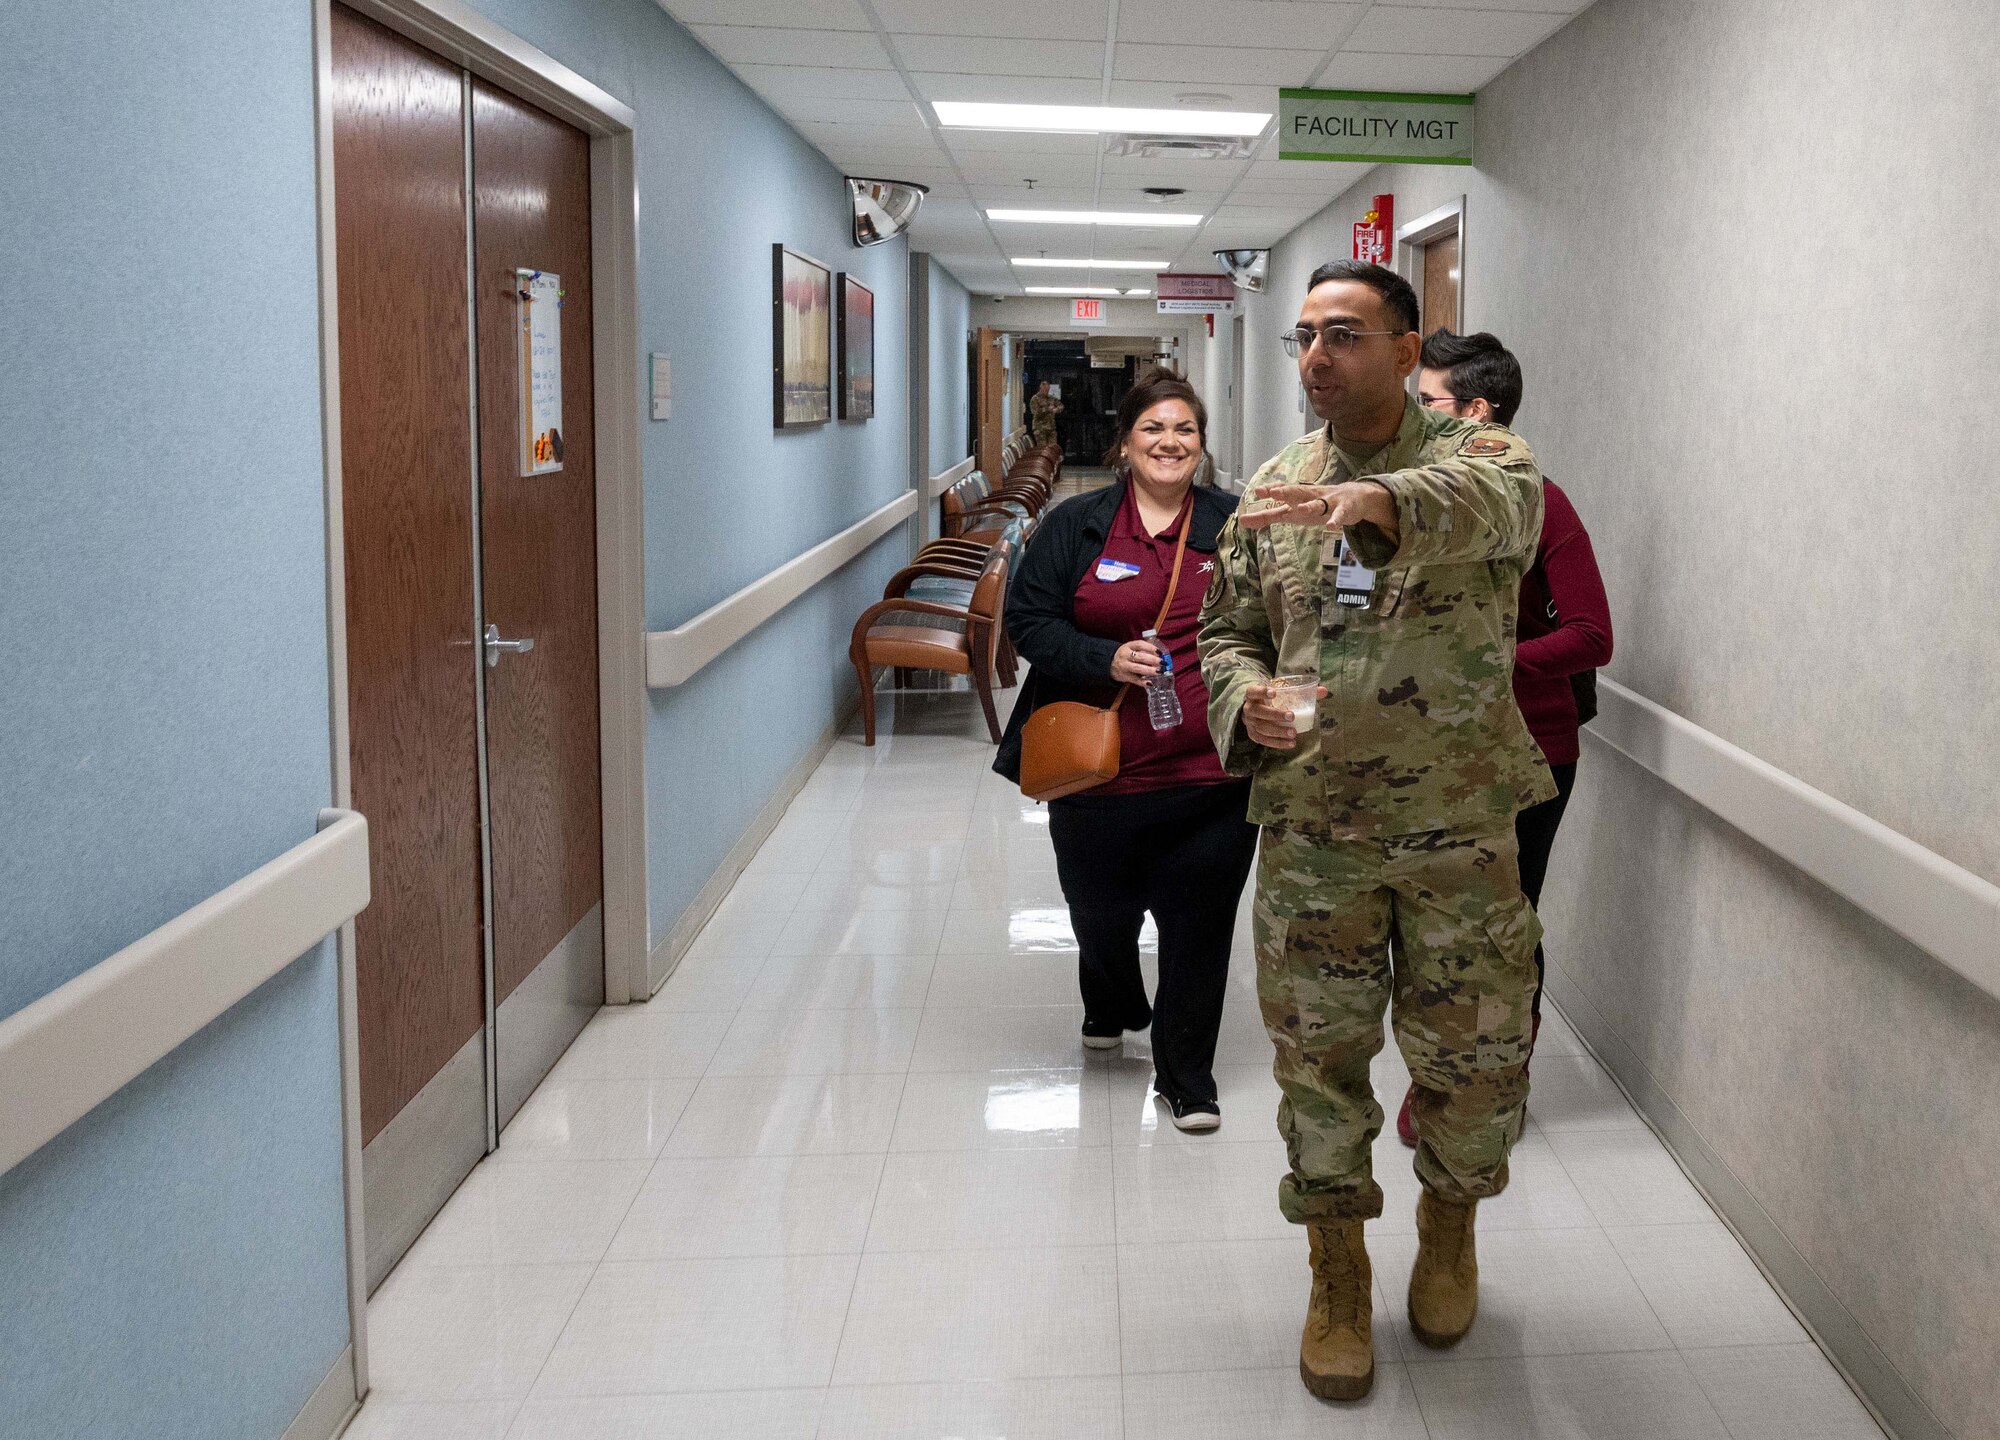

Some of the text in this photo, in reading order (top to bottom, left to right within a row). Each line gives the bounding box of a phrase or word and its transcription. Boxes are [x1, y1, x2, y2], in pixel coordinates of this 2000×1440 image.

[1294, 115, 1459, 140] FACILITY MGT
[1356, 230, 1374, 238] FIRE
[1077, 300, 1099, 318] EXIT
[1336, 593, 1368, 605] ADMIN
